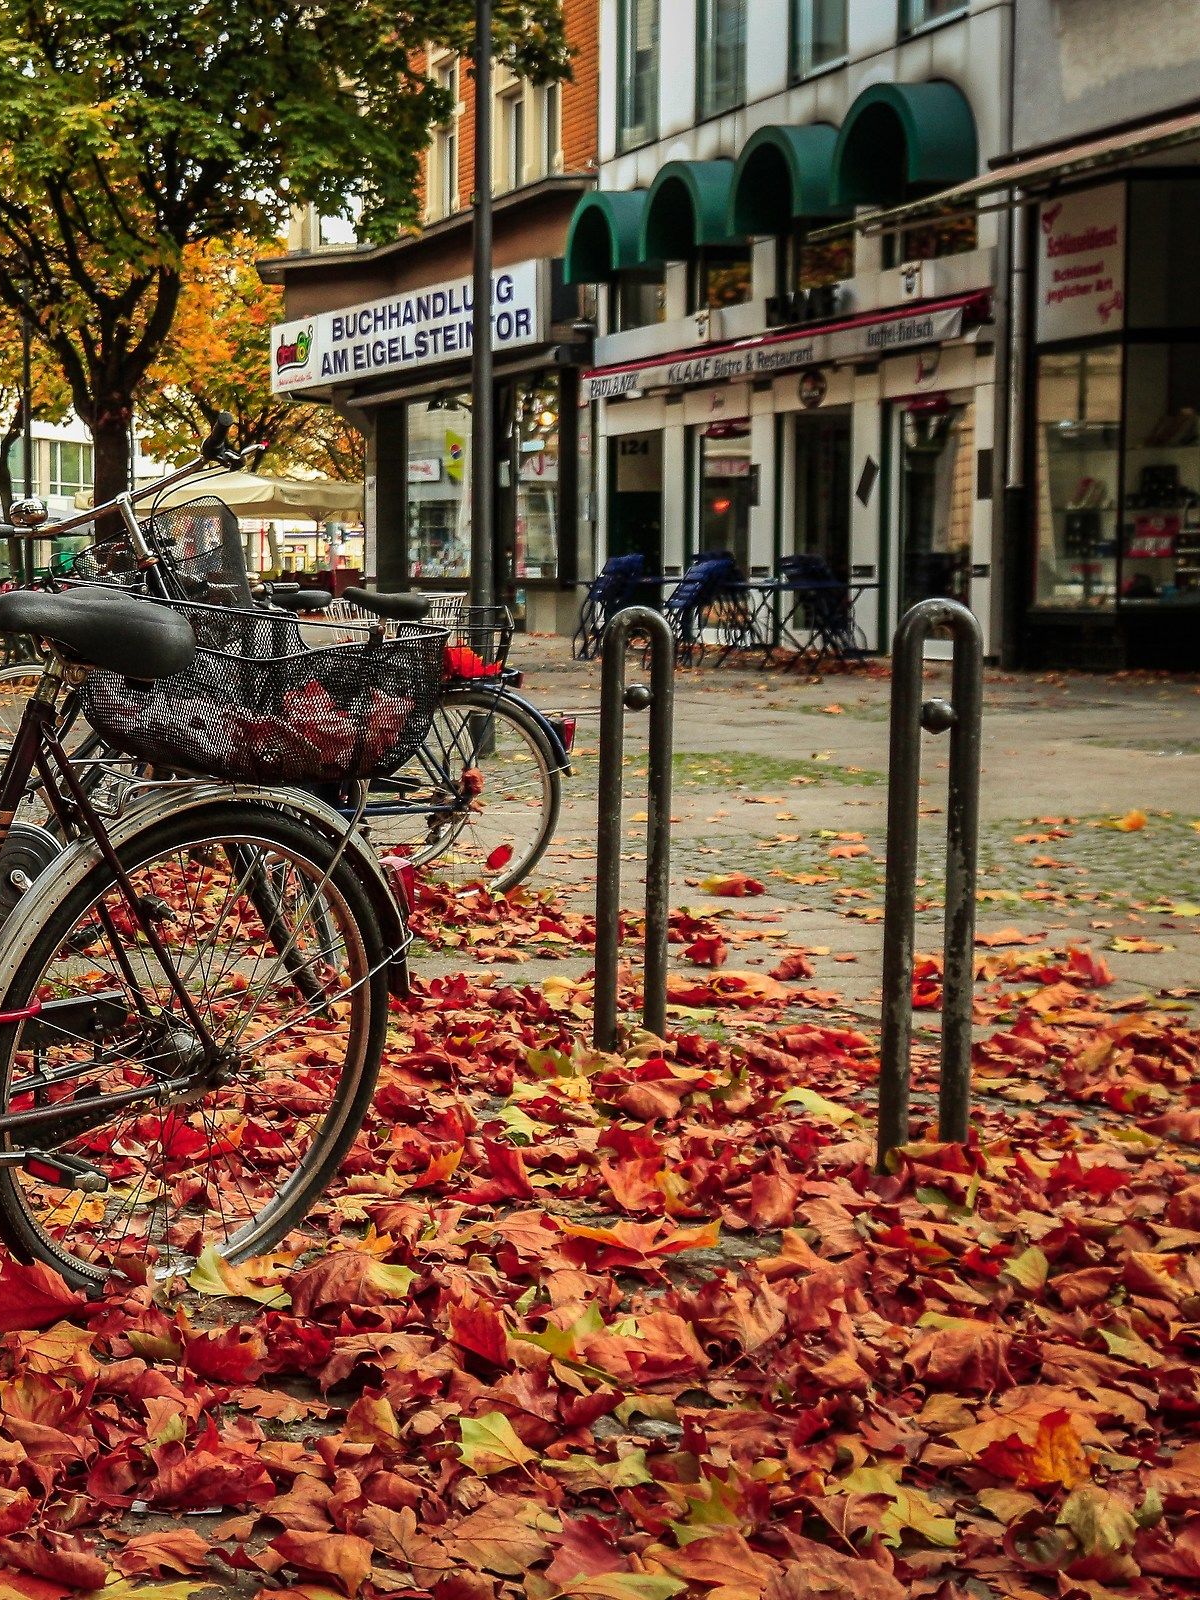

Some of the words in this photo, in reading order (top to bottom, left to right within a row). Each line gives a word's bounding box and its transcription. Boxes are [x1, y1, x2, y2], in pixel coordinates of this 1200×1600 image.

[1095, 278, 1113, 292] Art
[332, 275, 514, 342] BUCHHANDLUG
[321, 349, 349, 377] AM
[354, 308, 531, 370] EIGELSTEINOR
[667, 358, 711, 384] KLAAF
[714, 358, 743, 378] Bistro
[745, 354, 754, 372] &
[757, 345, 814, 369] Restaurant
[620, 440, 649, 455] 124
